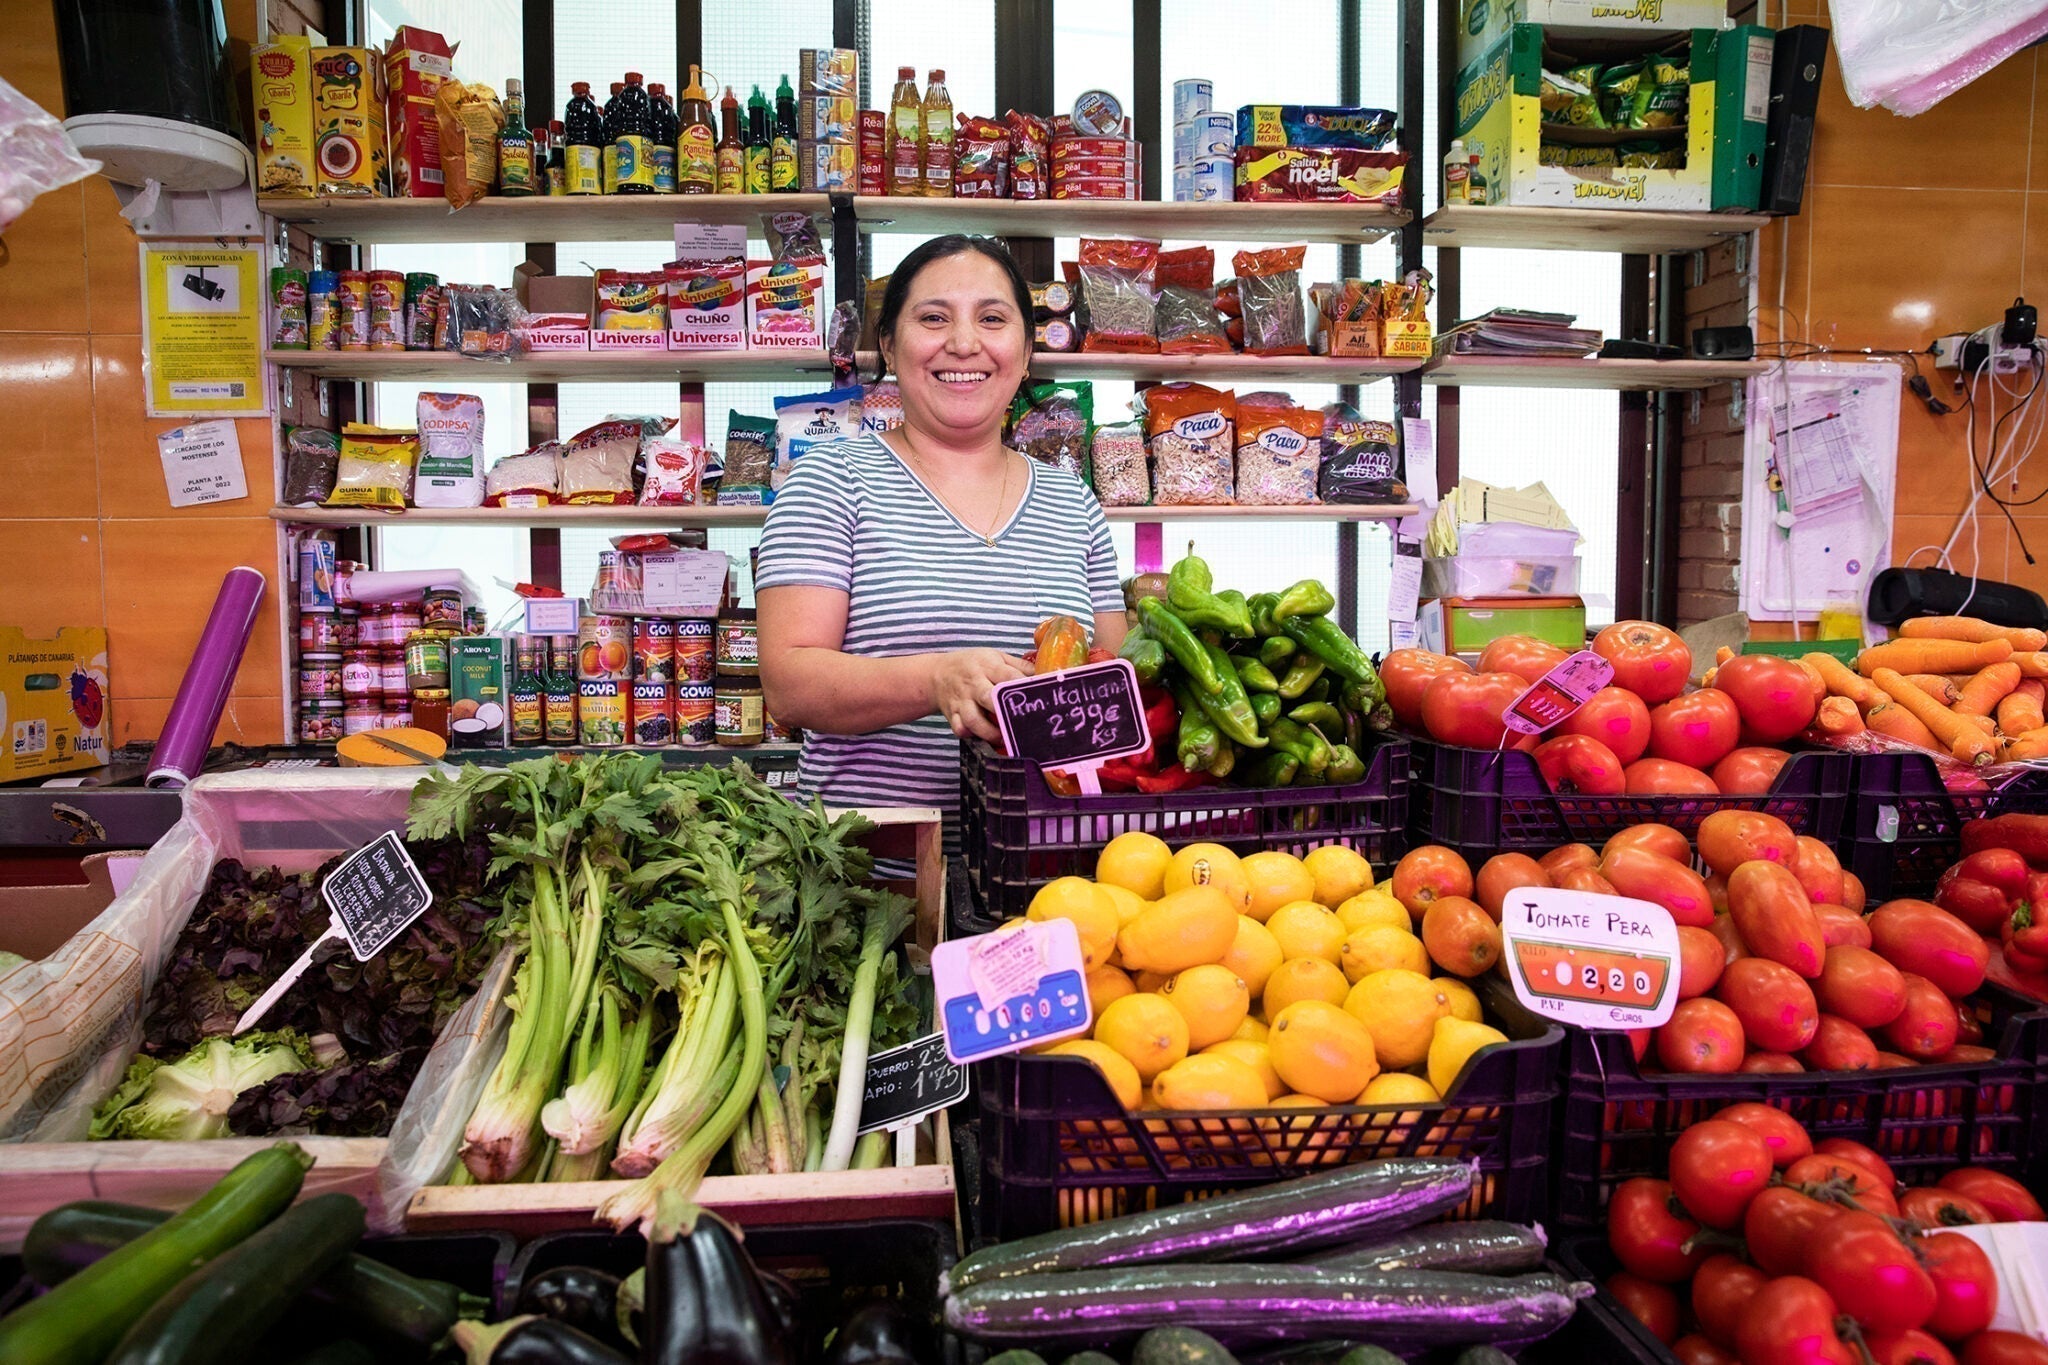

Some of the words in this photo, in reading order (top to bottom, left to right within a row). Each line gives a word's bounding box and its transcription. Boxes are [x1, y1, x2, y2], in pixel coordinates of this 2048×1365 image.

[863, 117, 884, 128] Real
[503, 139, 526, 147] GOYA
[1255, 134, 1281, 143] MORE
[1065, 142, 1081, 151] Real
[861, 164, 881, 174] Real
[1064, 163, 1080, 171] Real
[1065, 184, 1081, 192] Real
[760, 271, 809, 287] Universal
[611, 287, 659, 307] Universal
[680, 283, 734, 303] Universal
[685, 311, 730, 324] CHUÑO
[530, 332, 586, 344] niversal
[594, 332, 665, 344] Universal
[672, 331, 742, 343] Universal
[752, 334, 821, 346] Universal
[423, 419, 468, 431] CODIPSA
[804, 426, 840, 436] QUAKER
[1180, 417, 1220, 436] Paca
[213, 440, 225, 448] LOS
[1265, 432, 1301, 449] Paca
[181, 450, 218, 461] MOSTENSES
[1357, 452, 1390, 466] MAÍZ
[188, 477, 212, 485] PLANTA
[183, 486, 202, 494] LOCAL
[197, 493, 220, 501] CENTRO
[649, 624, 673, 637] GOY
[678, 624, 711, 636] GOYA
[40, 654, 47, 662] DE
[47, 653, 75, 662] CANARIAS
[580, 684, 616, 696] GOYA
[680, 686, 714, 698] GOYA
[514, 694, 537, 702] GOYA
[548, 694, 570, 702] GOYA
[514, 703, 539, 714] Salsita
[73, 735, 103, 752] Natur
[1523, 903, 1590, 929] TOMATE
[1605, 913, 1653, 938] PERA
[1541, 999, 1565, 1012] P.V.P.
